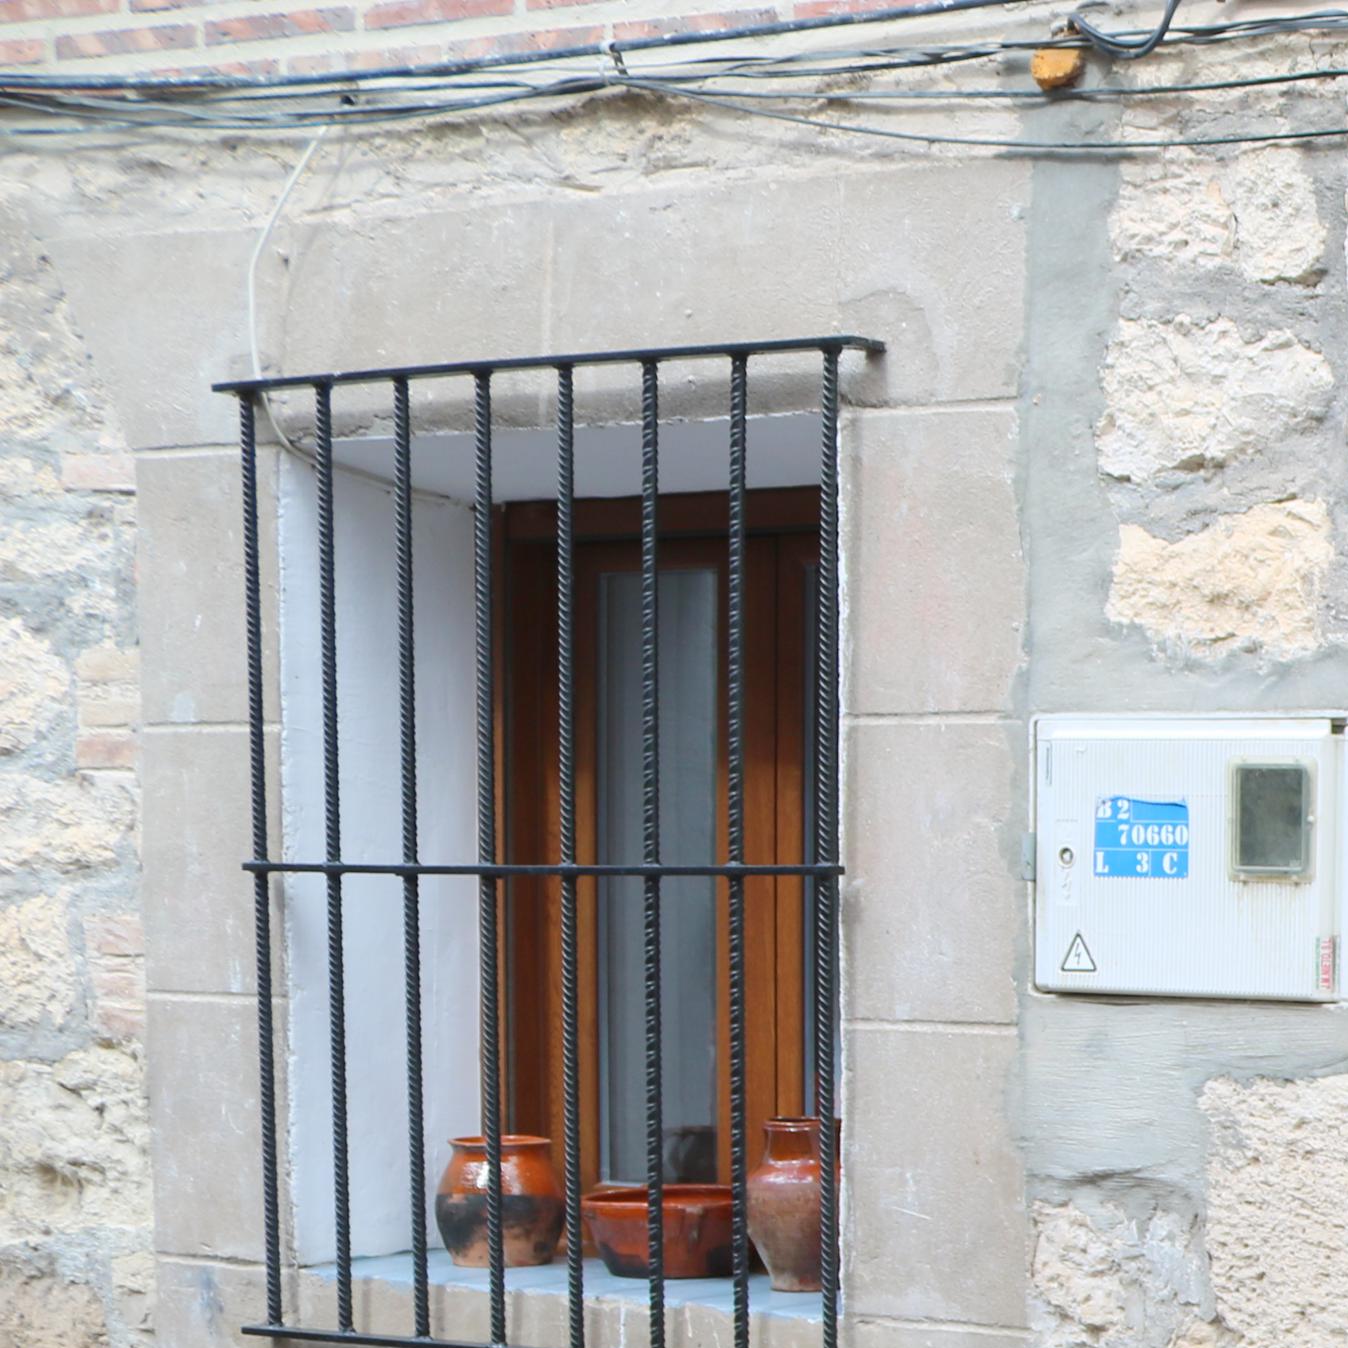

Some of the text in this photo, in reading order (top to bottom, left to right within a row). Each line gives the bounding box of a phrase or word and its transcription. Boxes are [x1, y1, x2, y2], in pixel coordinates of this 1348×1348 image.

[1116, 799, 1130, 819] 2
[1118, 824, 1188, 846] 70660
[1095, 851, 1178, 875] L 3 C
